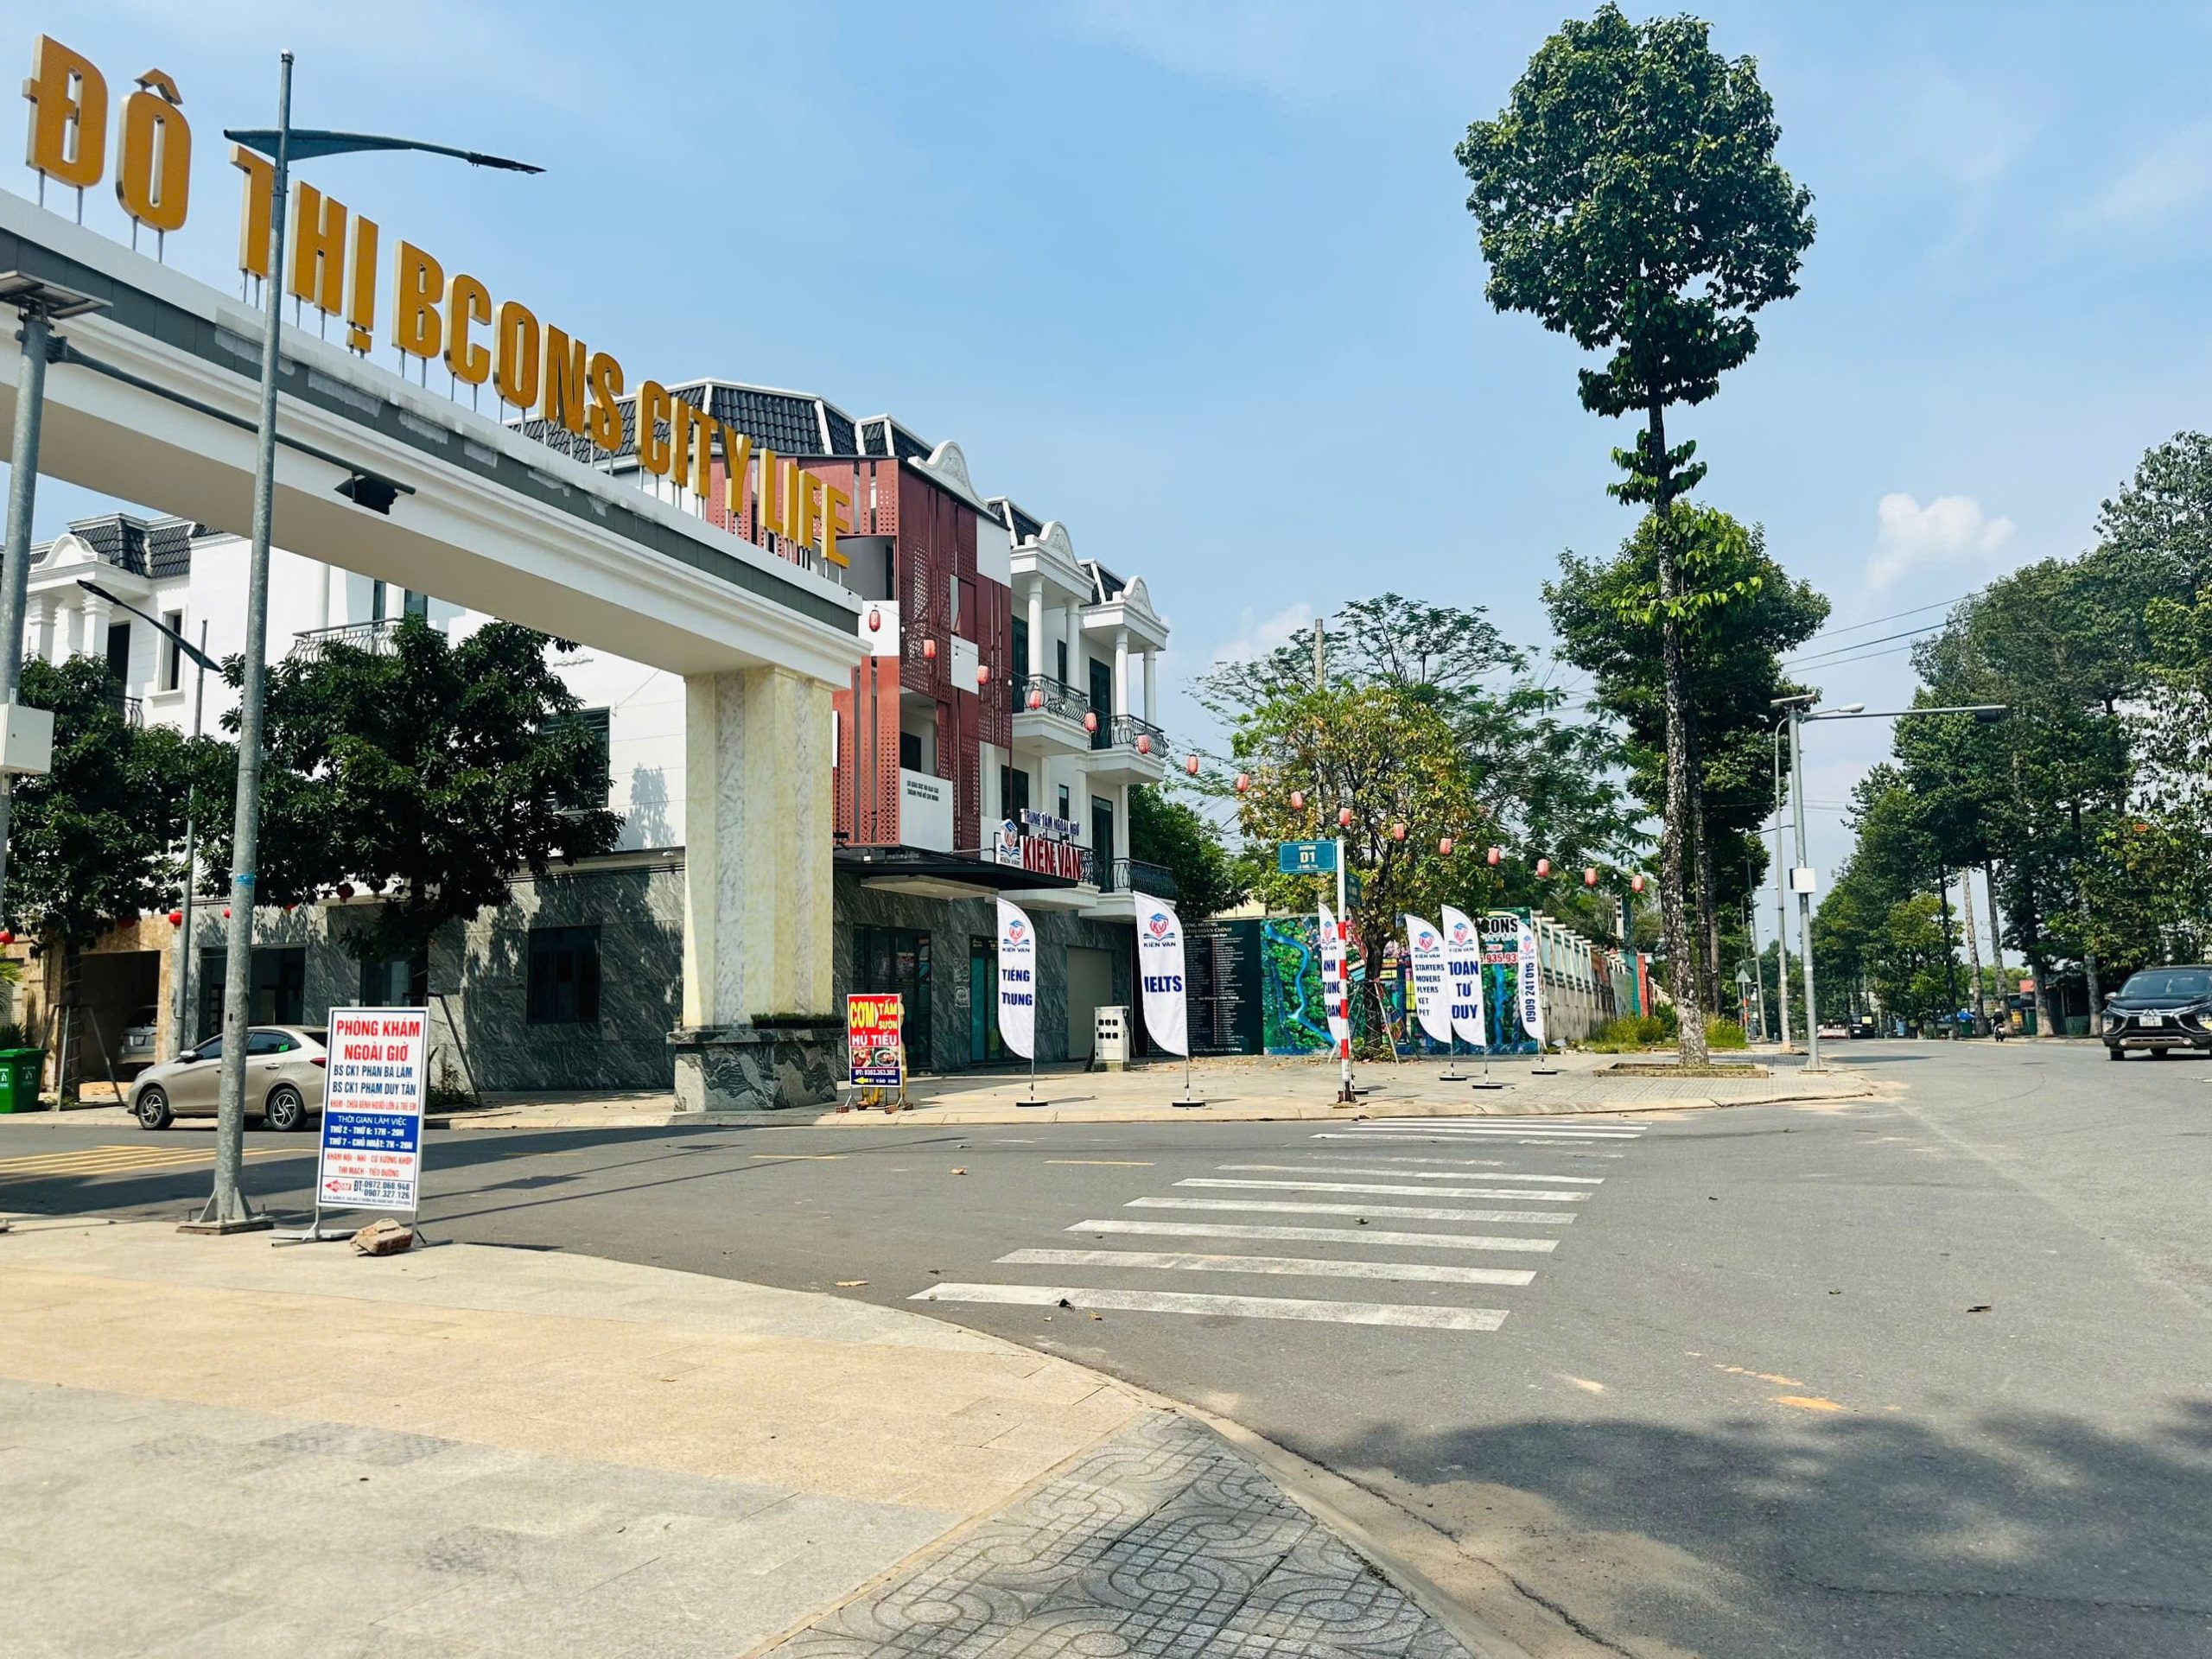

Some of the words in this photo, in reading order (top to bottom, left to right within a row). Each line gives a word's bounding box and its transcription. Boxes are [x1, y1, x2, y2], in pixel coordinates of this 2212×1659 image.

[22, 34, 192, 231] ĐÔ
[230, 144, 379, 353] THỊ
[391, 240, 623, 451] BCONS
[635, 380, 753, 514] CITY
[760, 448, 850, 569] LIFE
[1022, 831, 1054, 874] KIẾN
[1057, 839, 1082, 880] VĂN
[1001, 965, 1031, 982] TIẾNG
[1324, 959, 1336, 972] ANH
[1447, 958, 1479, 976] TOÁN
[1525, 962, 1535, 978] 015
[1144, 975, 1183, 993] IELTS
[1455, 980, 1472, 997] TƯ
[1525, 981, 1535, 996] 241
[877, 998, 898, 1015] TẤM
[1001, 991, 1033, 1007] TRUNG
[849, 1001, 874, 1029] CƠM
[1452, 1004, 1478, 1020] DUY
[1525, 998, 1536, 1023] 0909
[336, 1016, 378, 1036] PHÒNG
[383, 1017, 420, 1037] KHÁM
[852, 1030, 868, 1046] HỦ
[871, 1030, 897, 1046] TIẾU
[344, 1041, 382, 1061] NGOÀI
[387, 1041, 409, 1062] GIỜ
[334, 1065, 344, 1077] BS
[346, 1065, 359, 1077] CK1
[361, 1065, 382, 1077] PHAN
[333, 1081, 342, 1093] BS
[345, 1082, 358, 1093] CK1
[360, 1083, 383, 1096] PHẠM
[385, 1084, 399, 1095] DUY
[338, 1115, 354, 1123] THỜI
[374, 1116, 389, 1125] LÀM
[391, 1116, 407, 1126] VIỆC
[330, 1124, 342, 1134] THỨ
[342, 1125, 347, 1134] 2
[329, 1136, 342, 1146] THỨ
[342, 1137, 347, 1146] 7
[352, 1136, 365, 1147] CHỦ
